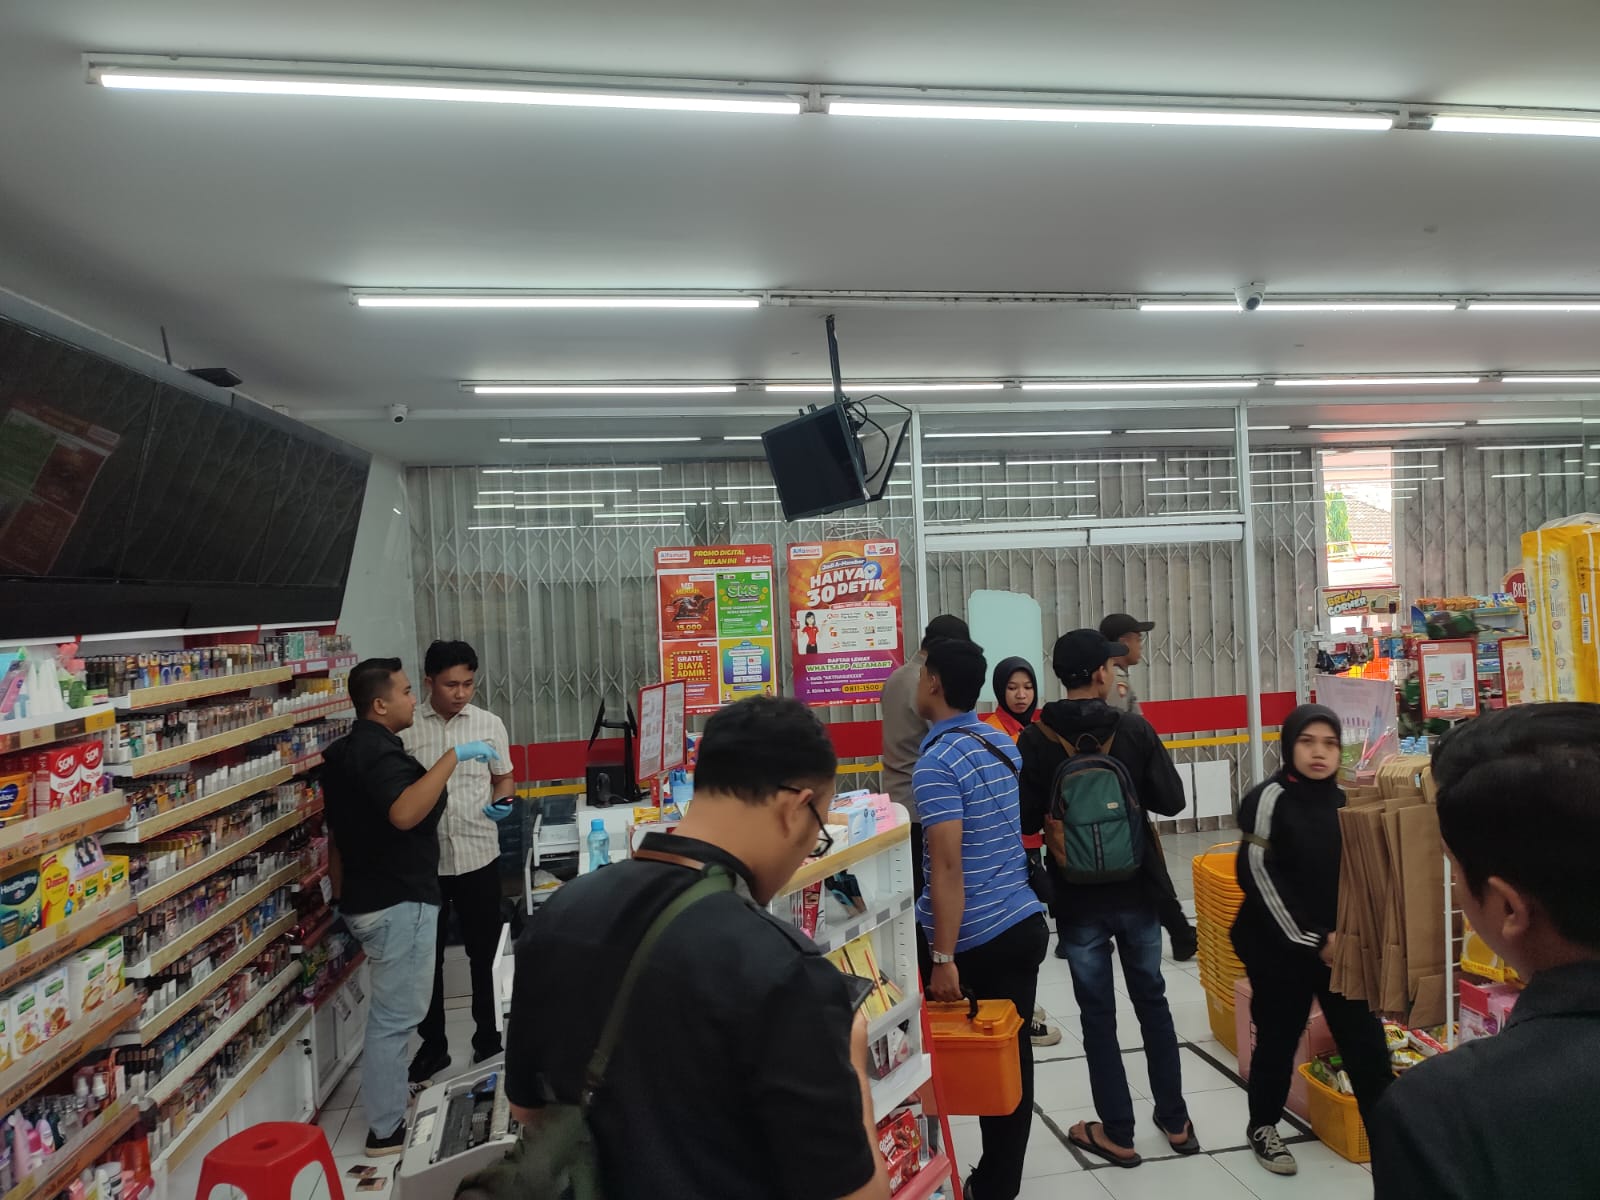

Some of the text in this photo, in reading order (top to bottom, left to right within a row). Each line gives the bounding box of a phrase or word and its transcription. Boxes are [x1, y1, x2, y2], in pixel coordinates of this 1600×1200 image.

[719, 548, 746, 556] DIGITAL
[810, 567, 865, 589] HANYA
[806, 578, 887, 607] 30 DETIK
[1512, 581, 1527, 598] BRE
[1327, 589, 1362, 607] BREAD
[1327, 596, 1368, 616] CORNER
[677, 655, 703, 663] GRATIS
[677, 662, 704, 670] BIAYA
[806, 660, 893, 672] WHATSAPP ALFAMART
[677, 669, 706, 678] ADMIN
[844, 683, 884, 692] 0811-1500-
[85, 747, 99, 763] SGM
[57, 754, 75, 773] SGM
